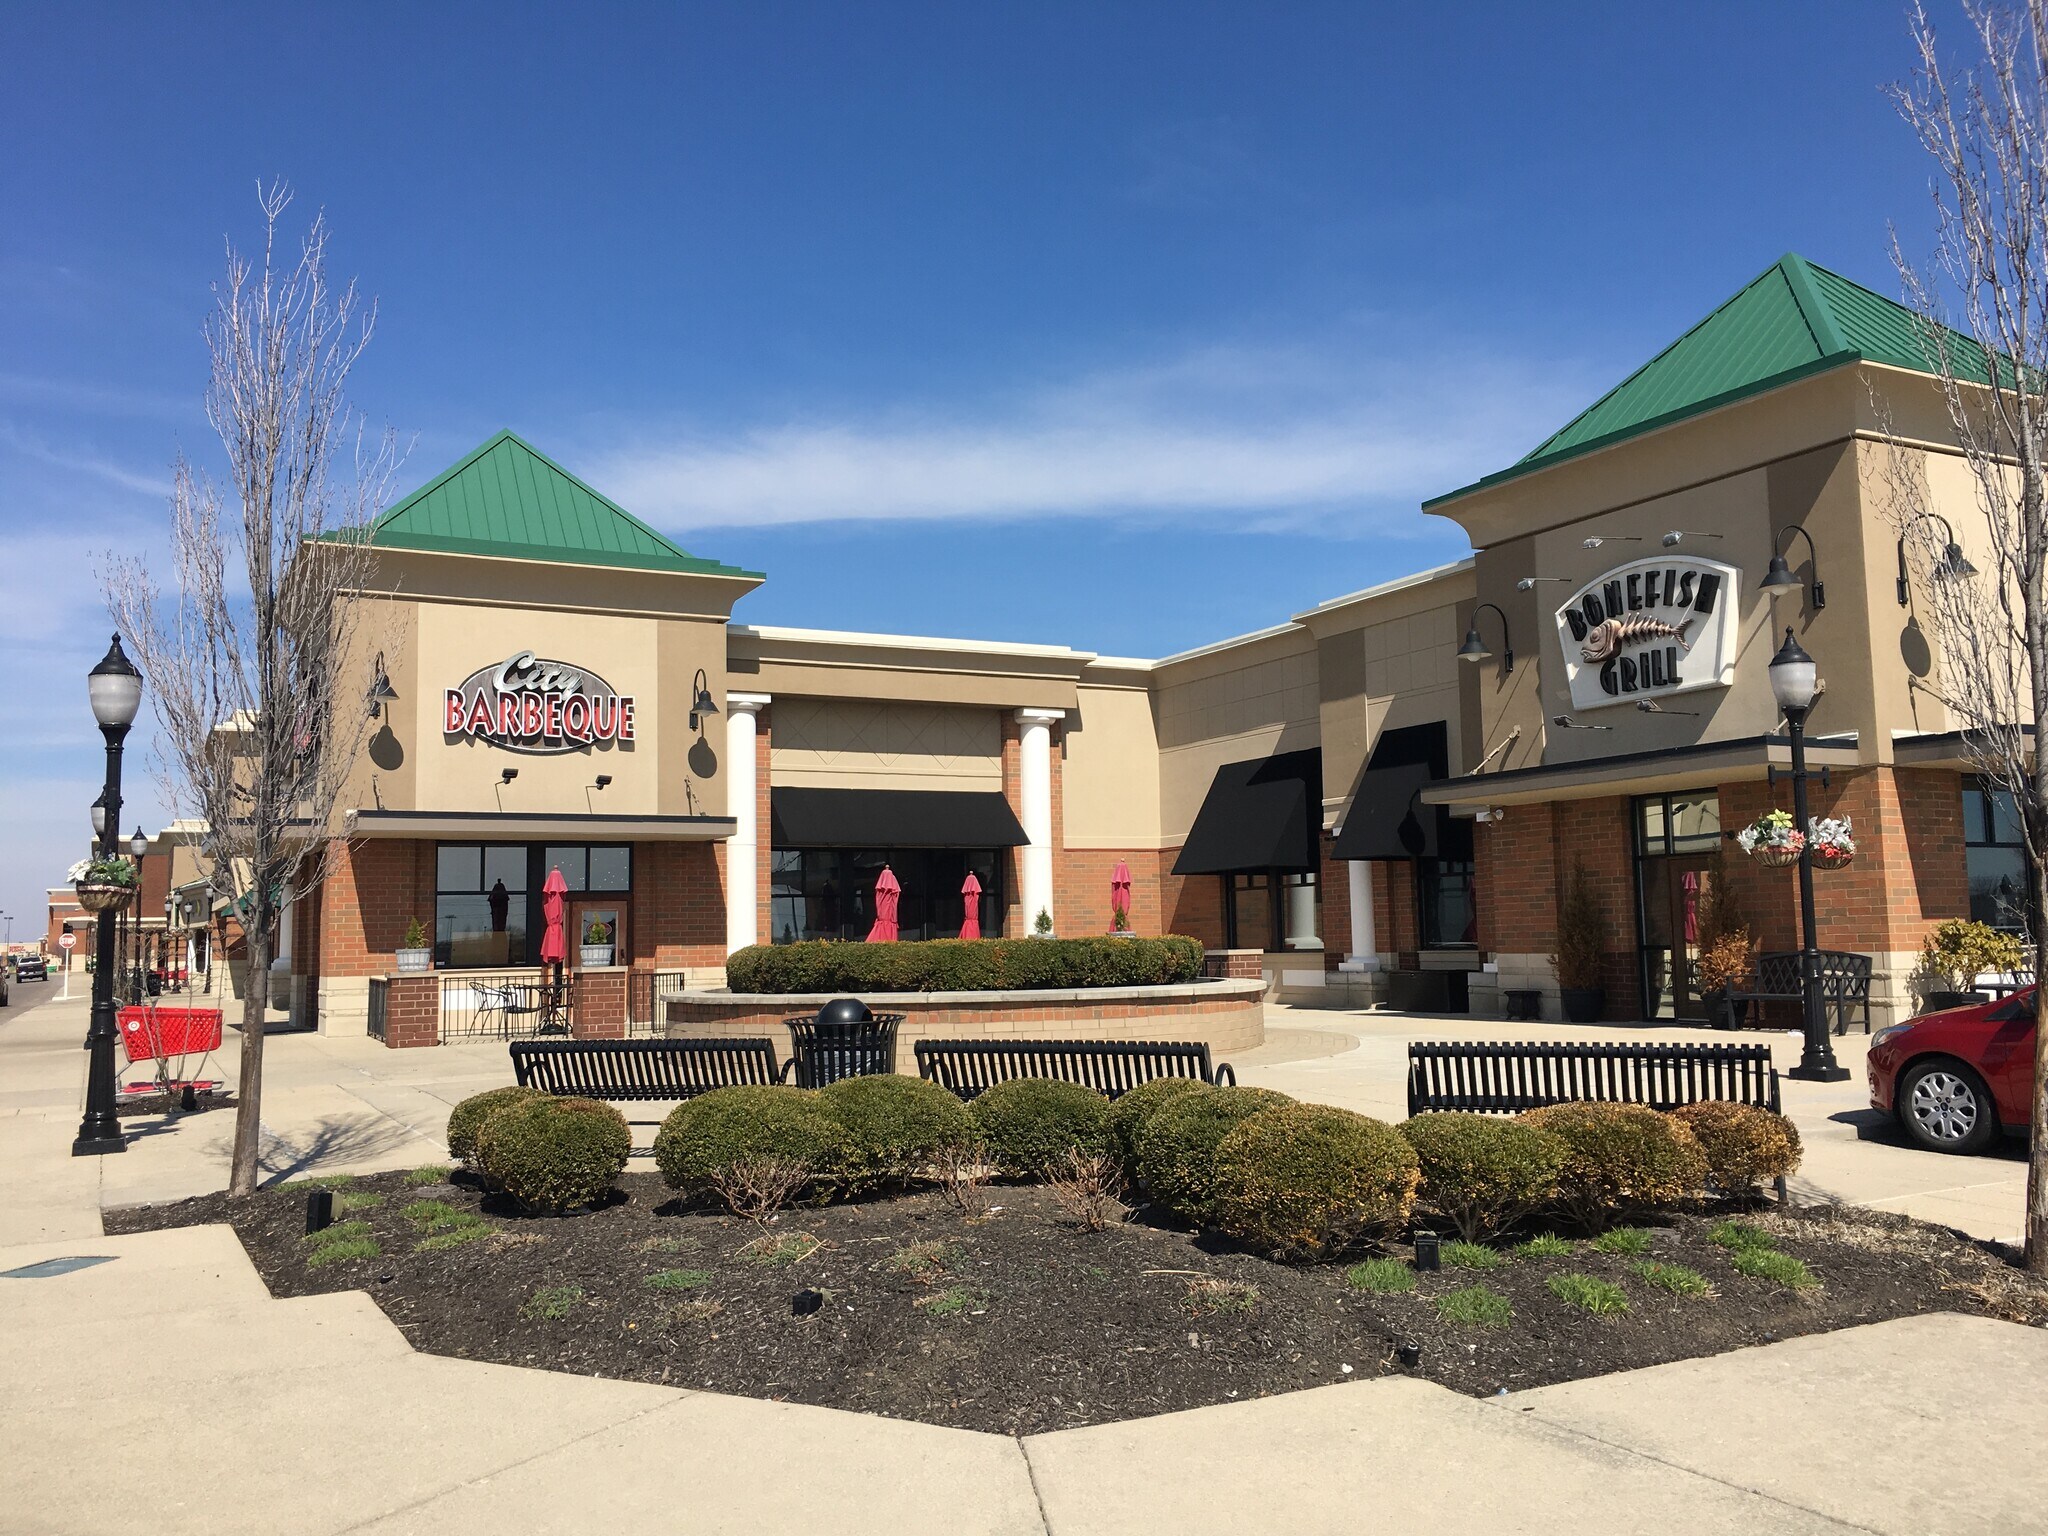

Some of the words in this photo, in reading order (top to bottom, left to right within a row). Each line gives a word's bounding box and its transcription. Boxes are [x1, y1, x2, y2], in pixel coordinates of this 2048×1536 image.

[1565, 569, 1721, 641] BONEFISH
[492, 649, 584, 700] City
[1600, 647, 1683, 695] GRILL
[444, 687, 635, 744] BARBEQUE
[61, 937, 75, 945] STOP
